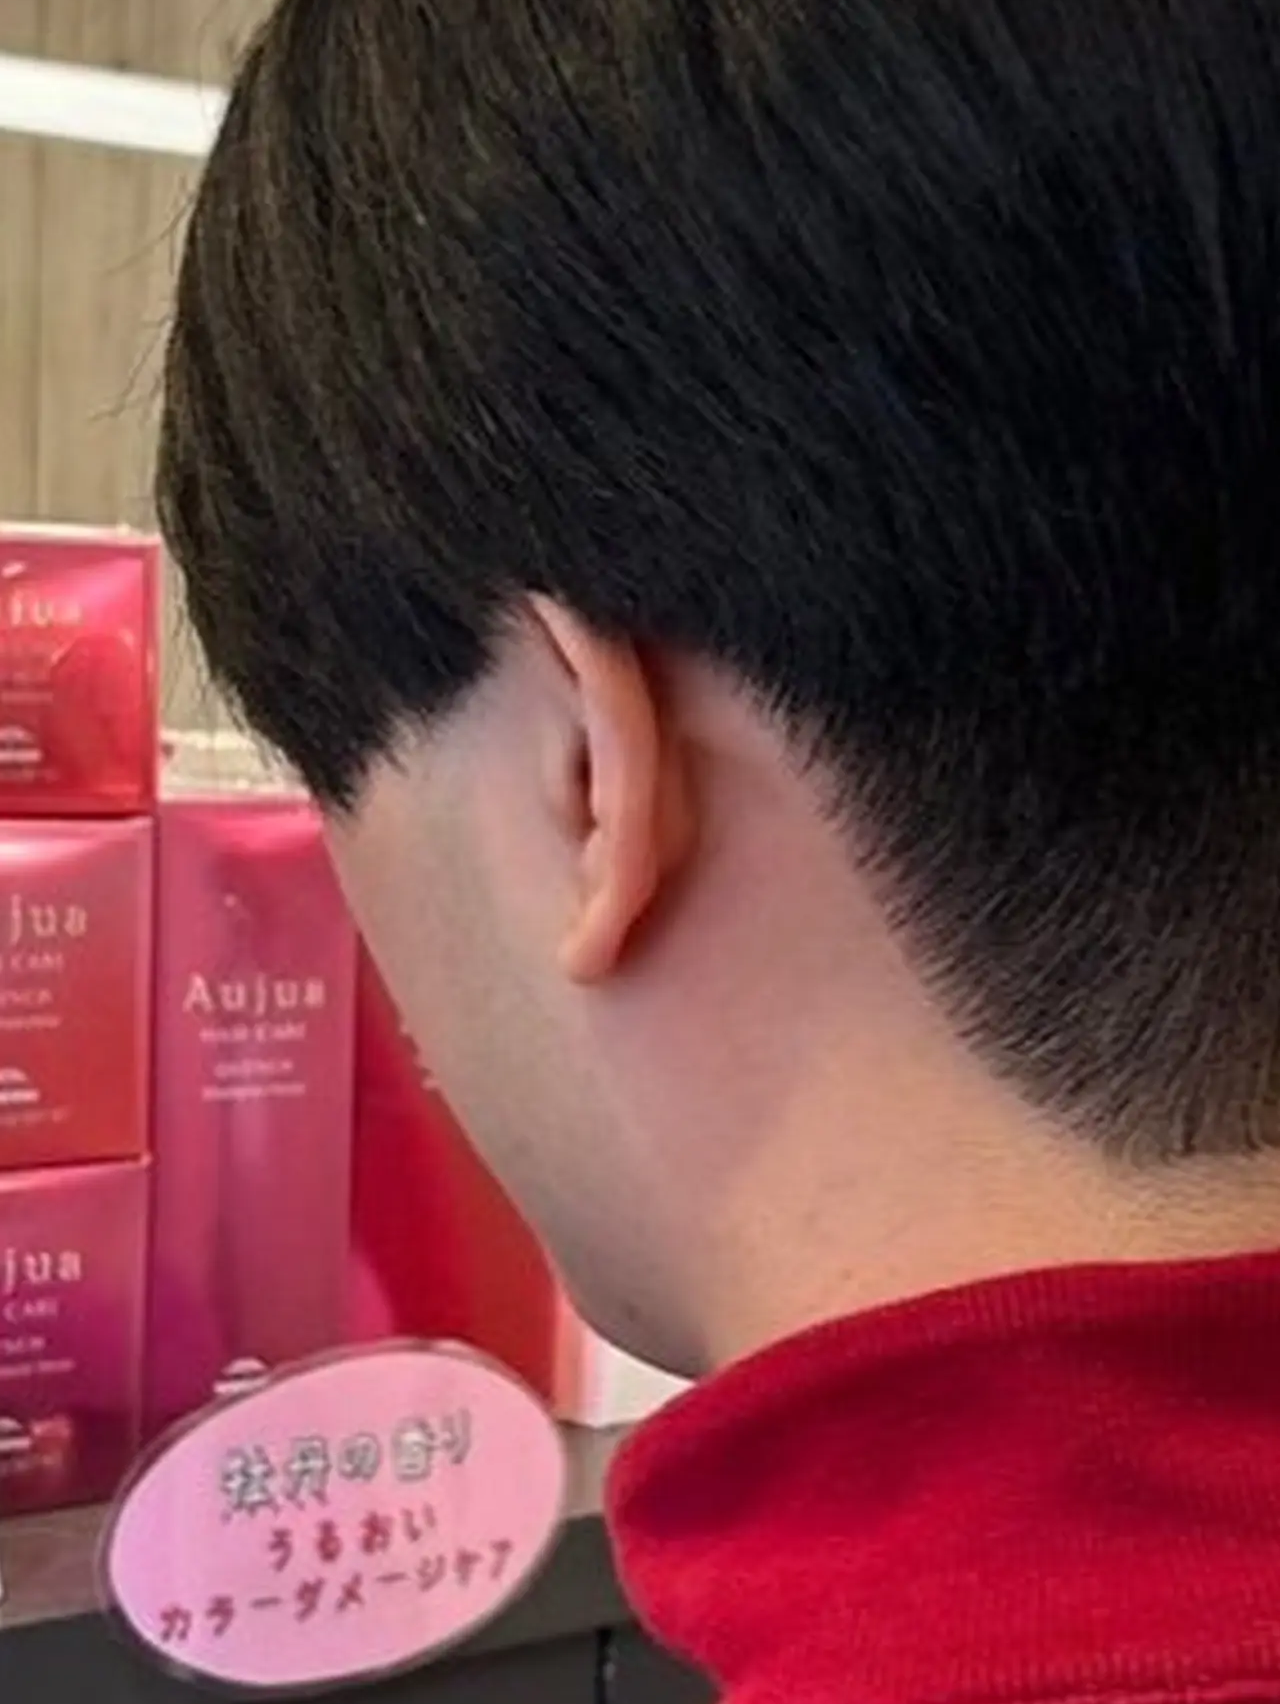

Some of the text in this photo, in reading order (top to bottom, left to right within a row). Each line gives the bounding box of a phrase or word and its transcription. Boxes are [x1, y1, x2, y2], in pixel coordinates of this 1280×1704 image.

[182, 970, 325, 1017] Aujua
[267, 1505, 437, 1572] うるおい
[159, 1539, 514, 1642] カラーダメージケア
